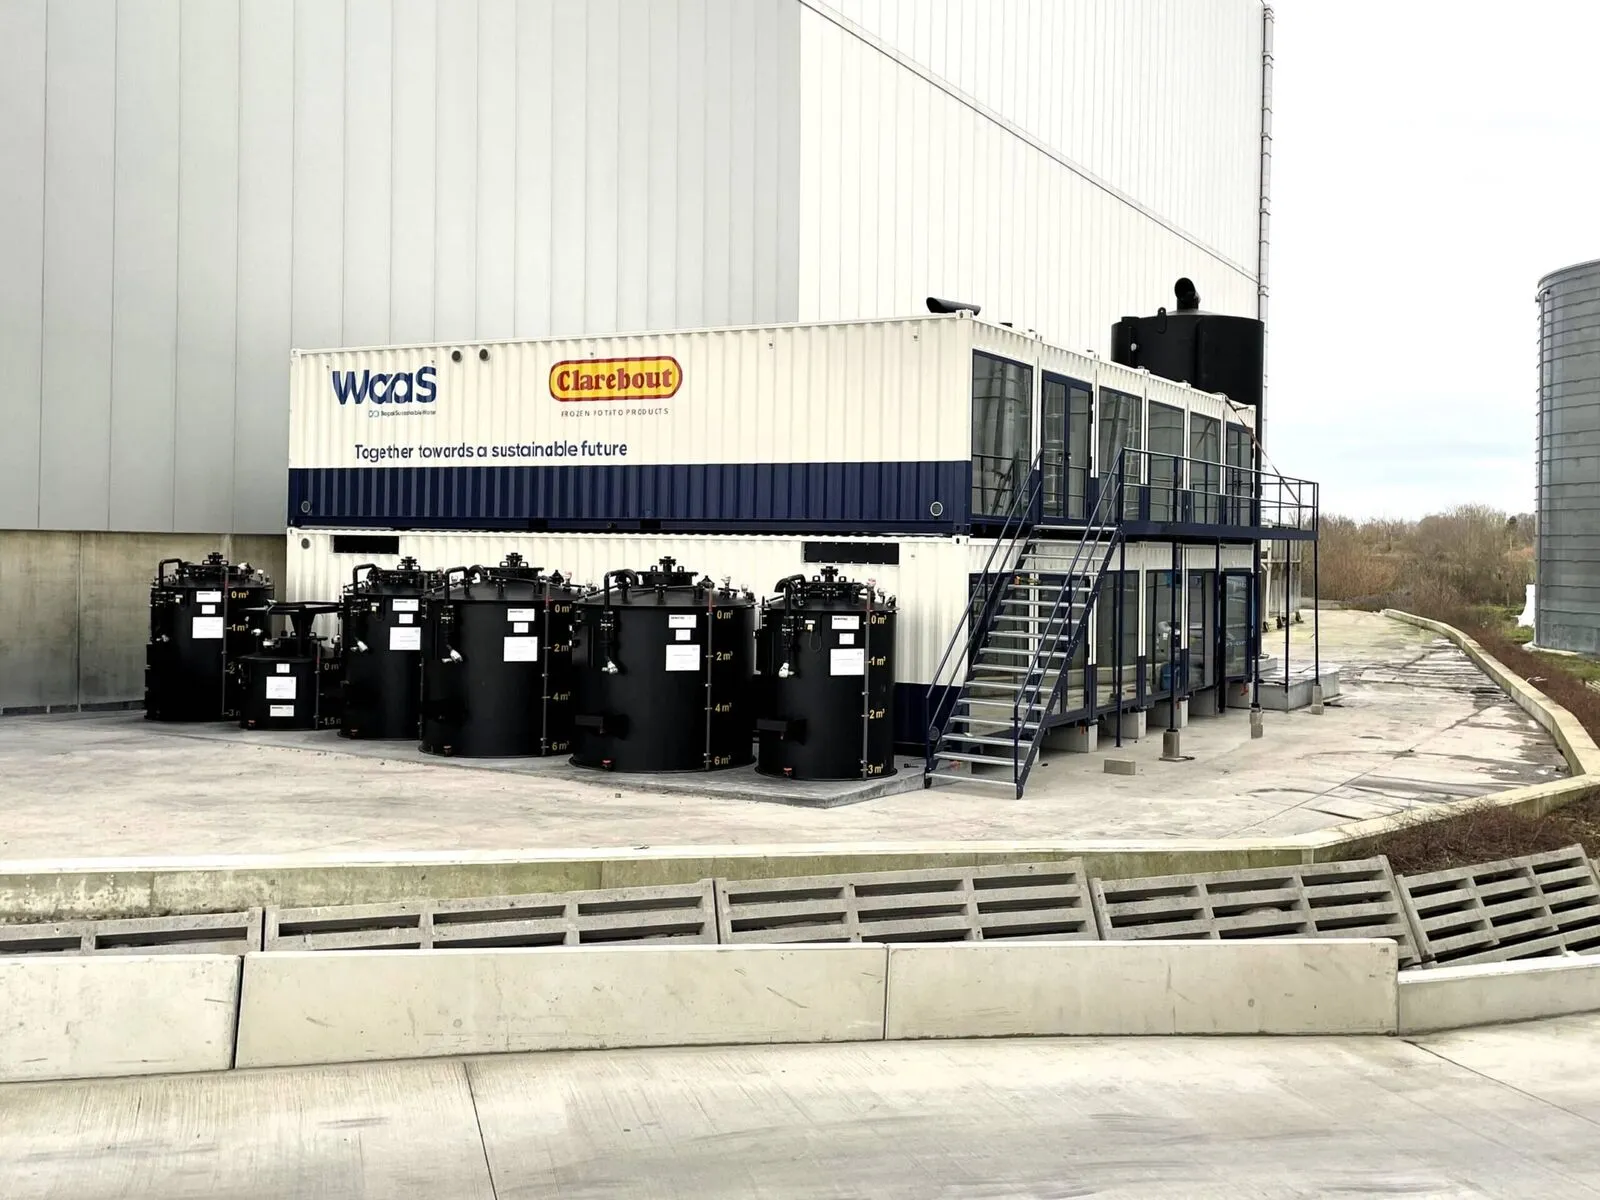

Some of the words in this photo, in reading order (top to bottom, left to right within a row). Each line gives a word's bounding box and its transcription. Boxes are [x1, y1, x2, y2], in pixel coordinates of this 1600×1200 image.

[556, 367, 673, 392] Clarebout
[332, 366, 437, 405] WaaS
[560, 409, 591, 418] FROZEN
[626, 407, 669, 416] PRODUCTS
[354, 443, 414, 463] Together
[418, 442, 474, 459] towards
[476, 447, 488, 458] a
[491, 440, 578, 458] sustainable
[580, 440, 628, 457] future
[231, 591, 236, 599] 0
[554, 604, 560, 613] 0
[716, 610, 722, 620] 0
[870, 616, 876, 625] 0
[231, 624, 236, 632] 1
[553, 643, 560, 653] 2
[716, 651, 722, 661] 2
[871, 657, 876, 666] 1
[553, 691, 559, 701] 4
[714, 703, 721, 712] 4
[869, 709, 875, 719] 2
[551, 741, 558, 750] 6
[714, 755, 720, 765] 6
[868, 764, 874, 774] 3
